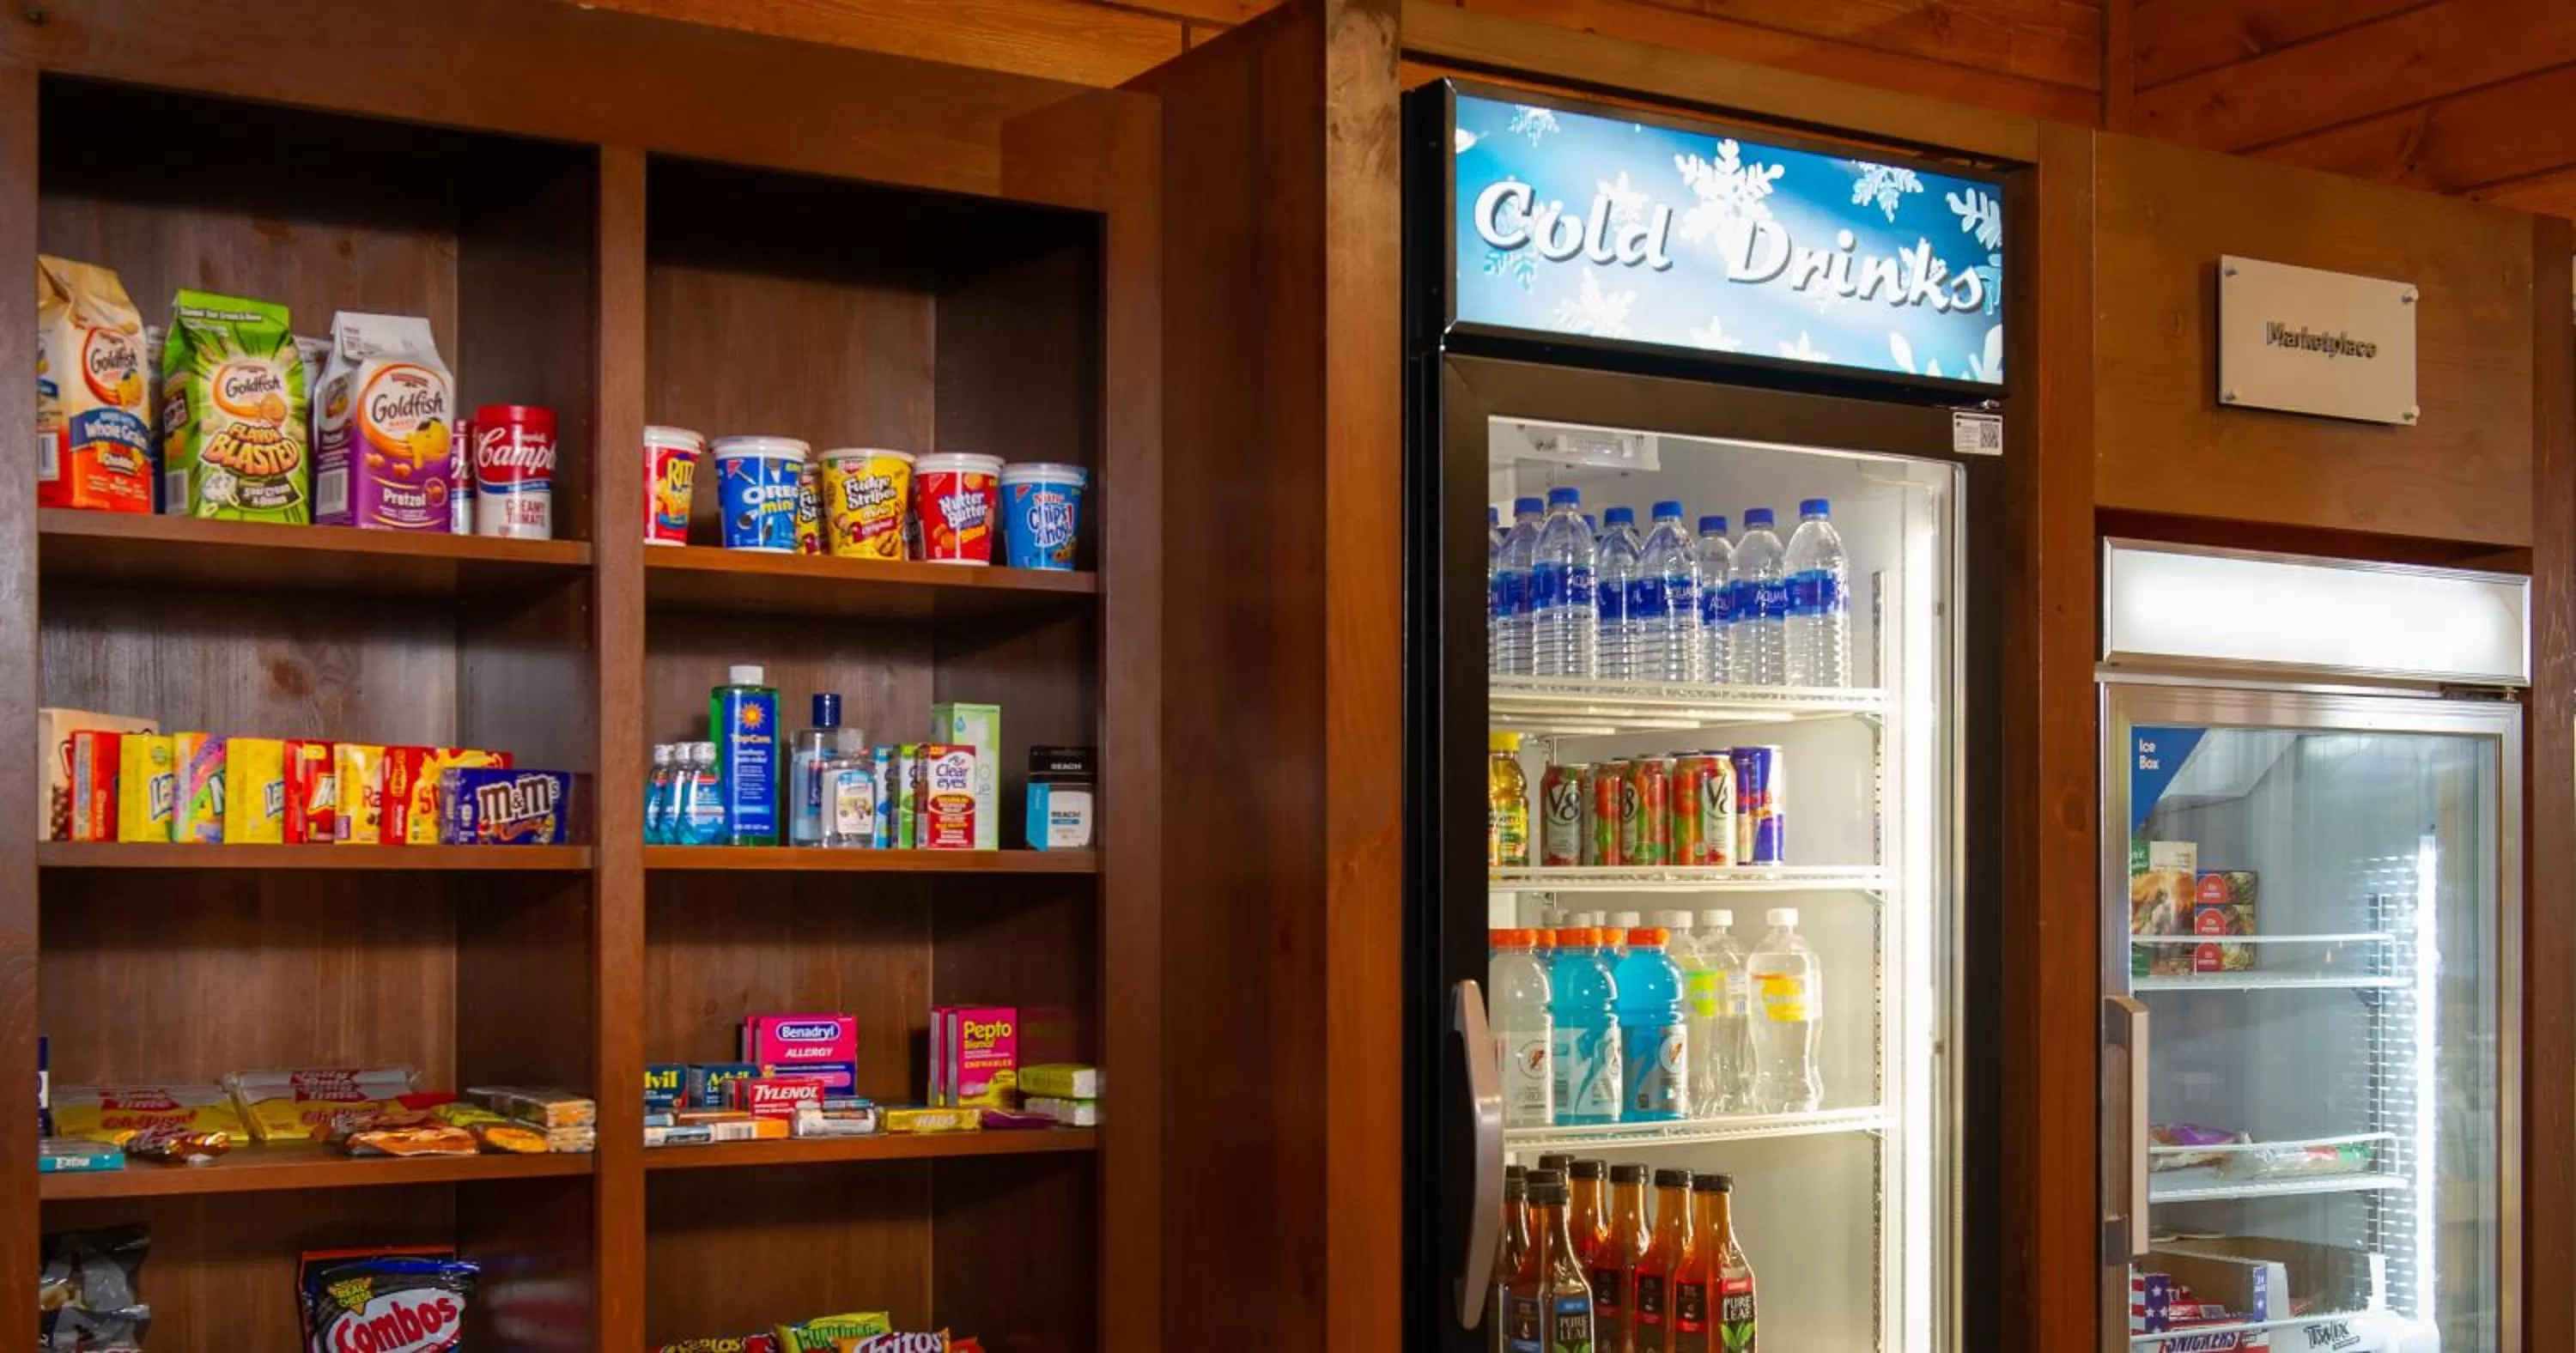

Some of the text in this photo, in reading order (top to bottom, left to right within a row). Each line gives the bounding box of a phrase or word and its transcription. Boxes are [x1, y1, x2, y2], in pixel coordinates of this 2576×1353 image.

[1473, 175, 1987, 314] Cold Drinks
[2264, 320, 2378, 360] Marketplace
[90, 345, 137, 374] Goldfish
[226, 376, 282, 398] Goldfish
[372, 391, 444, 422] Goldfish
[229, 424, 282, 445] FLAVOR
[206, 434, 300, 474] BLASTED
[383, 487, 426, 507] Pretzel
[506, 499, 545, 513] CEAMY
[848, 488, 896, 510] Stripes
[939, 492, 985, 514] Nutter
[2139, 738, 2156, 753] Ice
[936, 763, 969, 777] Clear
[1050, 761, 1083, 771] REACH
[2139, 755, 2160, 770] Box
[937, 778, 966, 791] eyes
[1549, 781, 1581, 821] V8
[781, 1025, 835, 1041] Benadryl
[963, 1020, 1012, 1039] Pepto
[785, 1047, 834, 1059] ALLERGY
[754, 1084, 821, 1103] TYLENOL
[1723, 1295, 1753, 1309] PURE
[1723, 1307, 1753, 1322] LEAF
[335, 1297, 458, 1353] Combos
[2304, 1320, 2349, 1349] TWIX
[2166, 1332, 2237, 1353] SNICKERS
